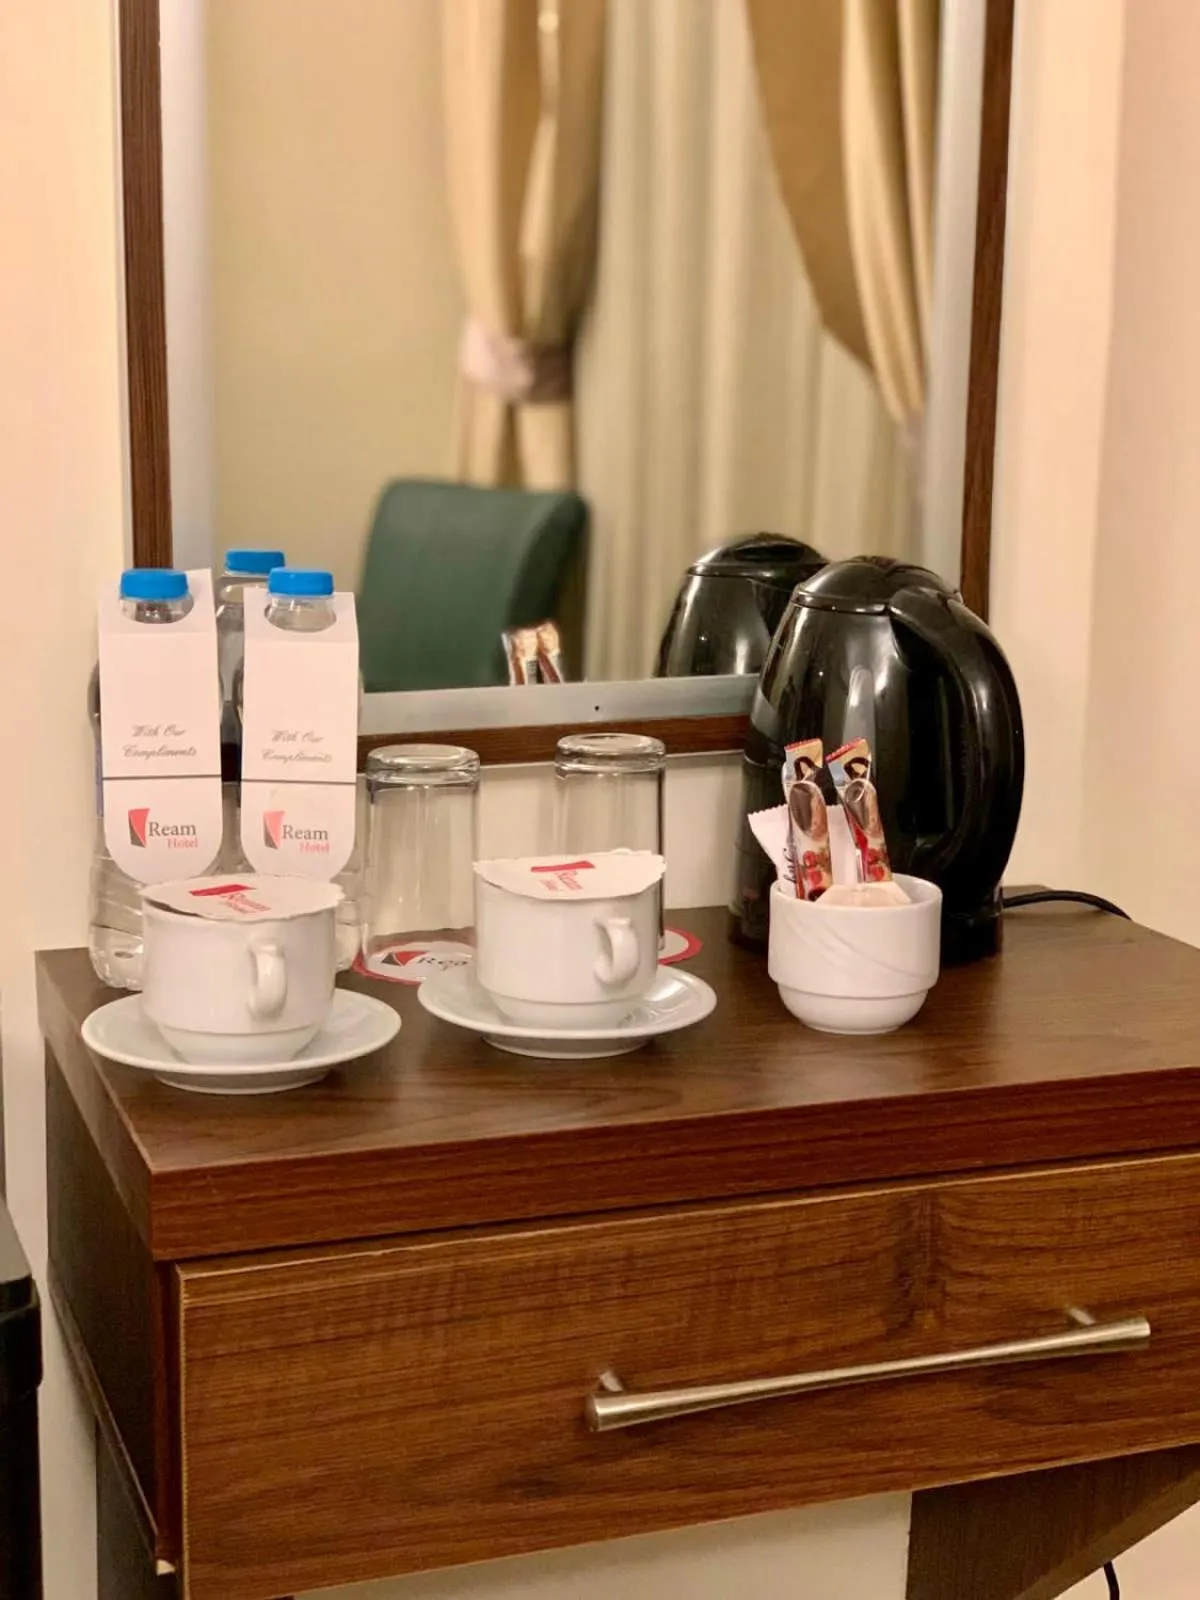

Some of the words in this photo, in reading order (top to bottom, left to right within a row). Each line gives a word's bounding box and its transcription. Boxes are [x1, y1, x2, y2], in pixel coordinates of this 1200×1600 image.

[122, 744, 197, 760] Compliments
[149, 822, 197, 837] Ream
[282, 825, 329, 841] Ream
[168, 837, 198, 849] Hotel
[300, 842, 330, 853] Hotel
